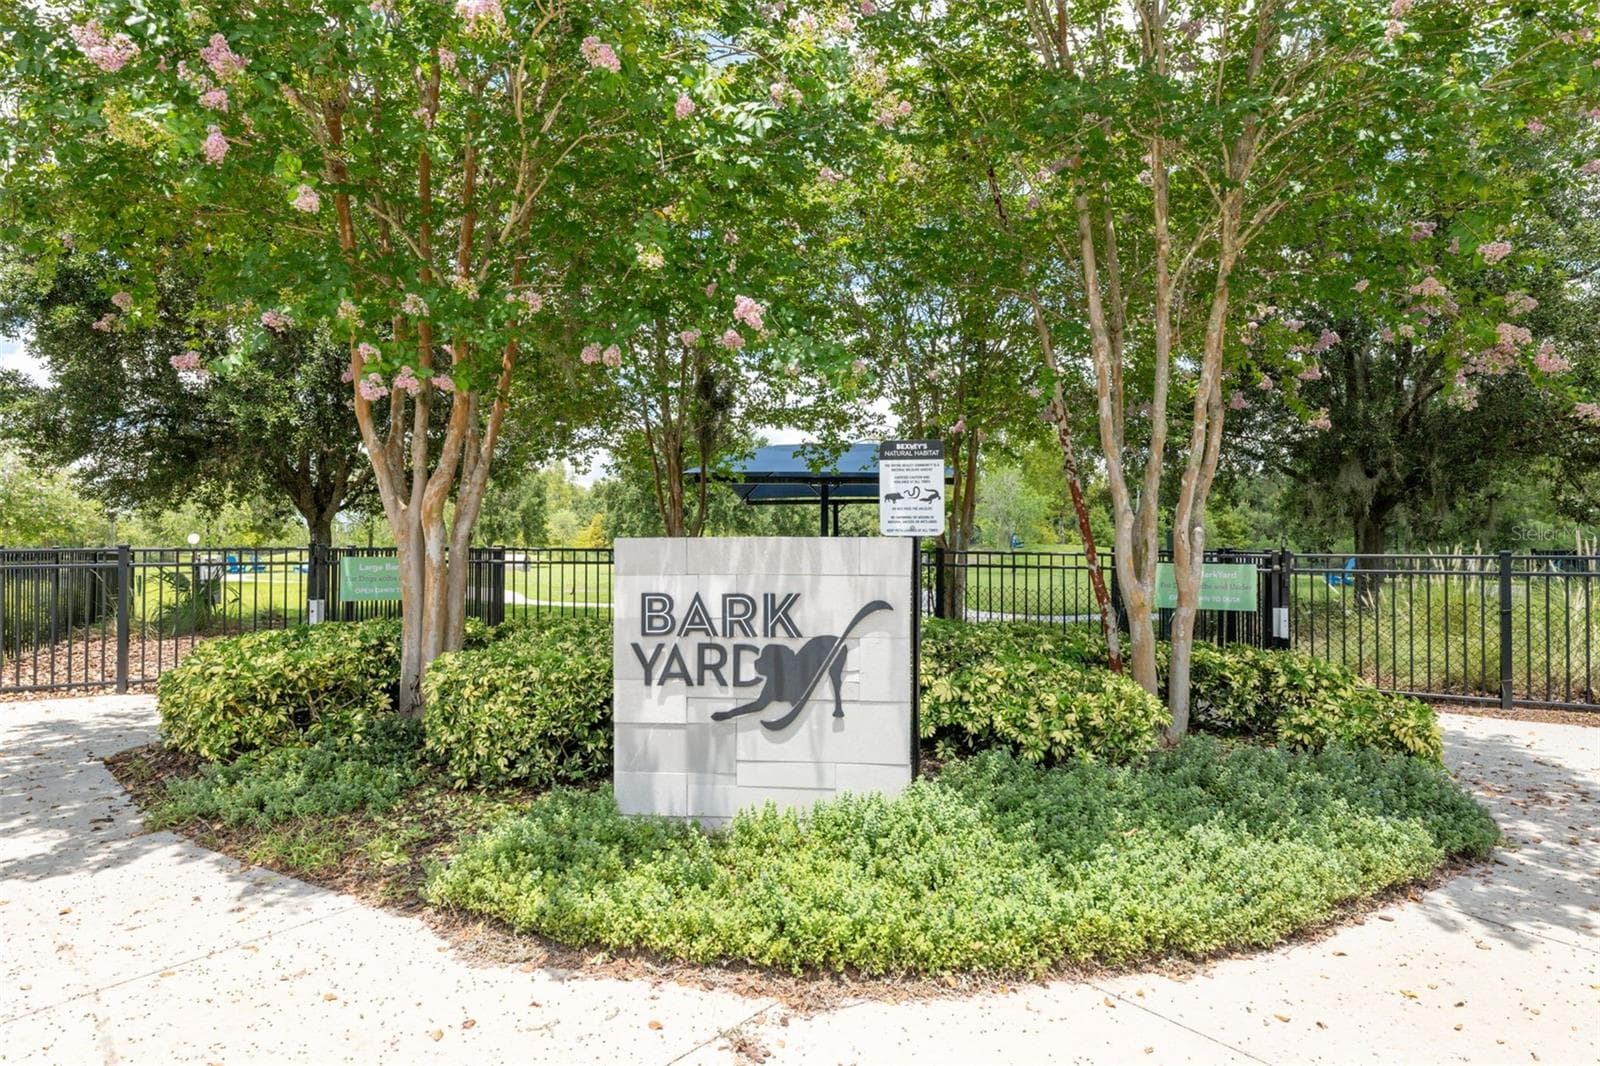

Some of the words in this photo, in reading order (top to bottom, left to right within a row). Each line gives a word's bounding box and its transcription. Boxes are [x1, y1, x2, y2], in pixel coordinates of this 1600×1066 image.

[359, 563, 384, 573] Large
[640, 591, 803, 638] BARK
[630, 642, 767, 688] YARD
